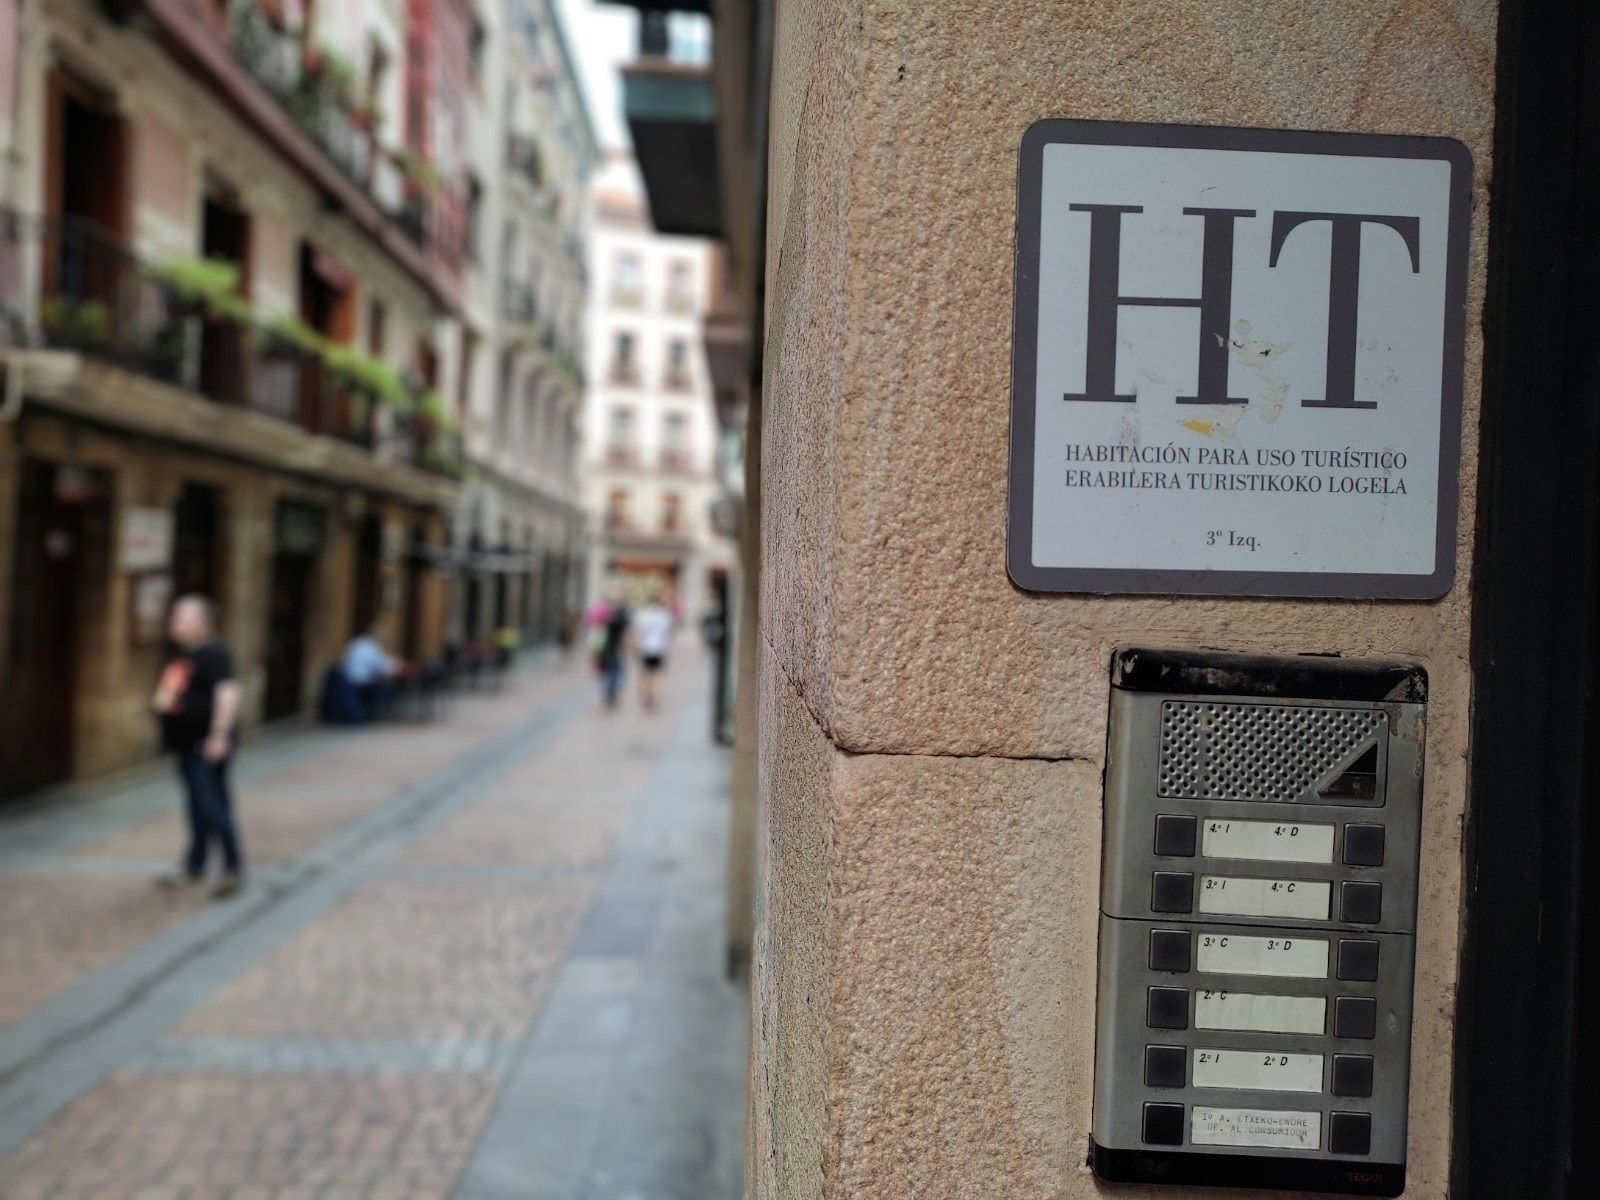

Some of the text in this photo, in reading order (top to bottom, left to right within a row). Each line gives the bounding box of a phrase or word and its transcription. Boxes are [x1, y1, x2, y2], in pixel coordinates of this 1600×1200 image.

[1063, 204, 1420, 409] HT
[1066, 441, 1407, 470] HABITACIÓN PARA USO TURÍSTICO
[1066, 469, 1407, 494] ERABILERA TURISTIKOKO LOGELA
[1229, 531, 1261, 551] Izq.
[1291, 827, 1298, 836] D
[1288, 883, 1295, 892] C
[1284, 941, 1291, 950] D
[1220, 990, 1228, 1000] C
[1280, 1057, 1288, 1065] D
